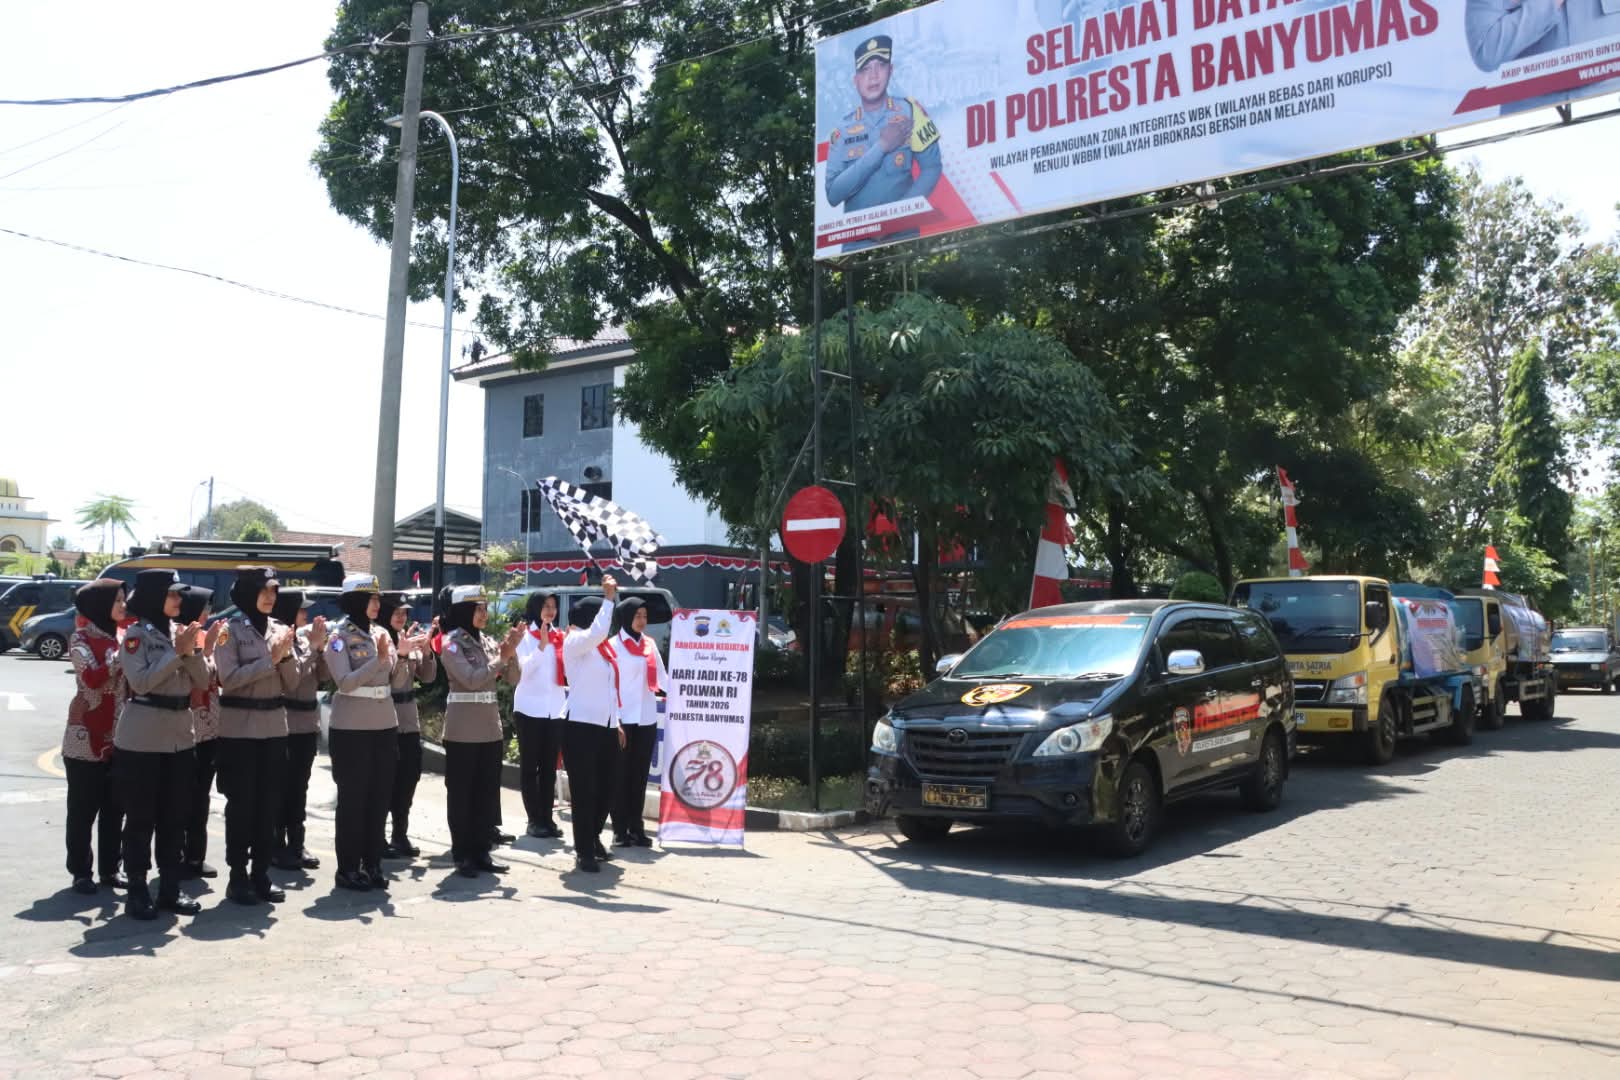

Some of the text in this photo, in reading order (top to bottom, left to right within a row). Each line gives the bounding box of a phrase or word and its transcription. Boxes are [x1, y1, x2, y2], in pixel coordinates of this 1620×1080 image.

[1026, 0, 1177, 75] SELAMAT
[966, 0, 1438, 148] DI POLRESTA BANYUMAS
[1501, 68, 1521, 79] AKBP
[1523, 59, 1559, 75] WAHYUDI
[1560, 51, 1594, 65] SATRIYO
[990, 146, 1028, 169] WILAYAH
[1030, 132, 1099, 160] PEMBANGUNAN
[1101, 127, 1127, 142] ZONA
[1129, 111, 1186, 136] INTEGRITAS
[1188, 105, 1212, 123] WBK
[1269, 84, 1304, 105] BEBAS
[1307, 78, 1334, 95] DARI
[1033, 155, 1070, 174] MENUJU
[1072, 147, 1102, 166] WBBM
[1153, 121, 1207, 147] BIROKRASI
[1209, 113, 1247, 135] BERSIH
[1249, 108, 1272, 125] DAN
[674, 641, 714, 650] RANGKAIAN
[672, 669, 748, 683] HARI JADI KE-78
[679, 684, 738, 698] POLWAN RI
[686, 700, 709, 709] TAHUN
[669, 712, 745, 724] POLRESTA BANYUMAS
